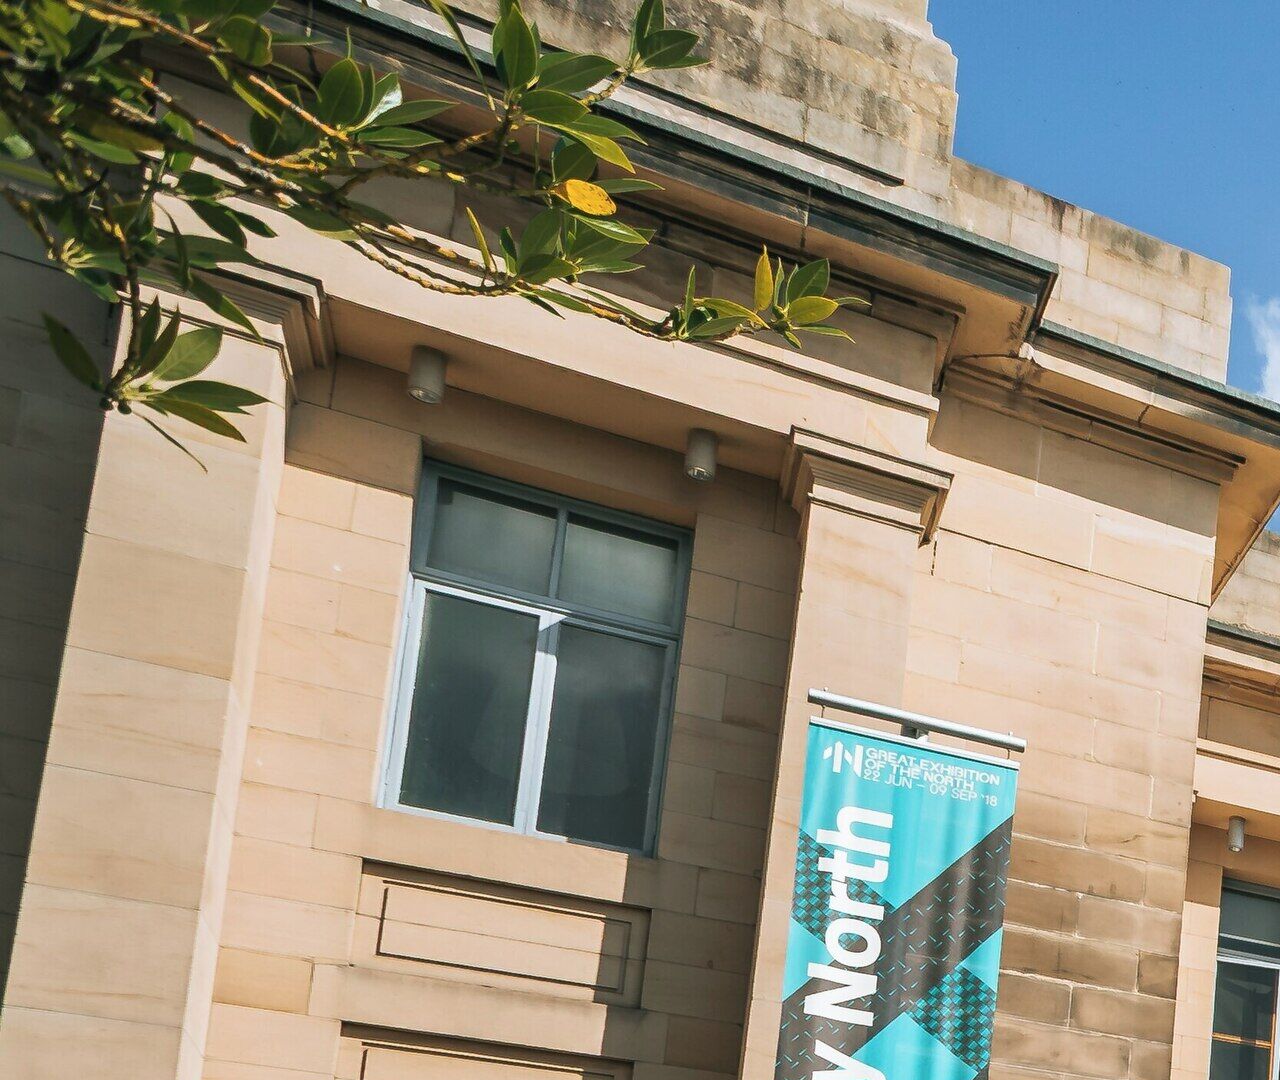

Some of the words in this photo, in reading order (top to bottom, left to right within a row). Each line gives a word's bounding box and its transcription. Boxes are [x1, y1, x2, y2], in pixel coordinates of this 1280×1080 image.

[865, 747, 916, 769] GREAT
[918, 758, 1001, 786] EXHIBITION
[865, 758, 886, 772] OF
[891, 763, 921, 779] THE
[923, 768, 975, 791] NORTH
[863, 769, 881, 783] 22
[884, 772, 913, 790] JUN
[929, 782, 947, 797] 09
[950, 786, 978, 802] SEP
[803, 805, 894, 1028] North
